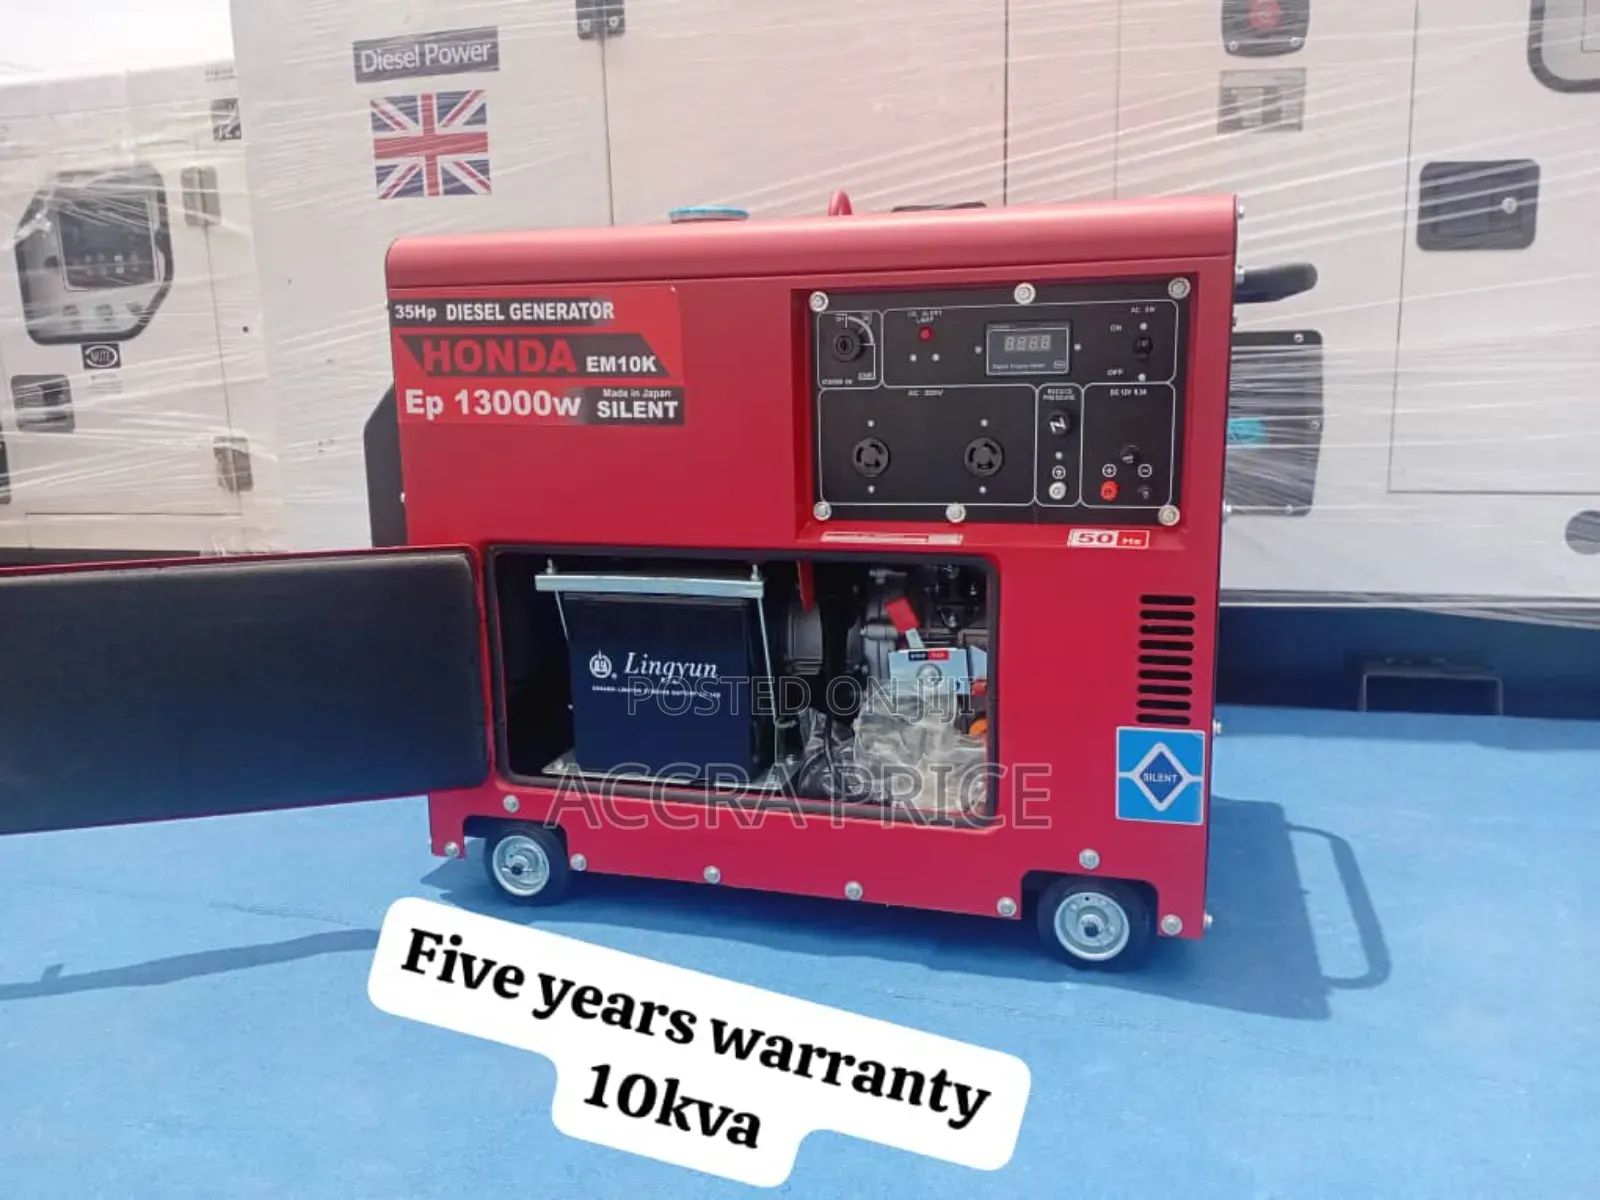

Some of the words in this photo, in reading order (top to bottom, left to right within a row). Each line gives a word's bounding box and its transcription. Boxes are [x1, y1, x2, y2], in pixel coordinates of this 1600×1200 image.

[361, 44, 420, 73] Diesel
[424, 42, 492, 66] Power
[395, 304, 437, 321] 35Hp
[446, 303, 505, 321] DIESEL
[509, 302, 615, 321] GENERATOR
[422, 339, 576, 373] HONDA
[586, 356, 657, 373] EM10K
[603, 388, 628, 398] Made
[630, 388, 640, 397] in
[643, 388, 672, 400] Japan
[405, 389, 444, 421] Ep
[454, 388, 581, 417] 13000w
[597, 401, 679, 418] SILENT
[1078, 532, 1114, 544] 50
[624, 652, 719, 684] Lingyun
[1143, 773, 1178, 783] SILENT
